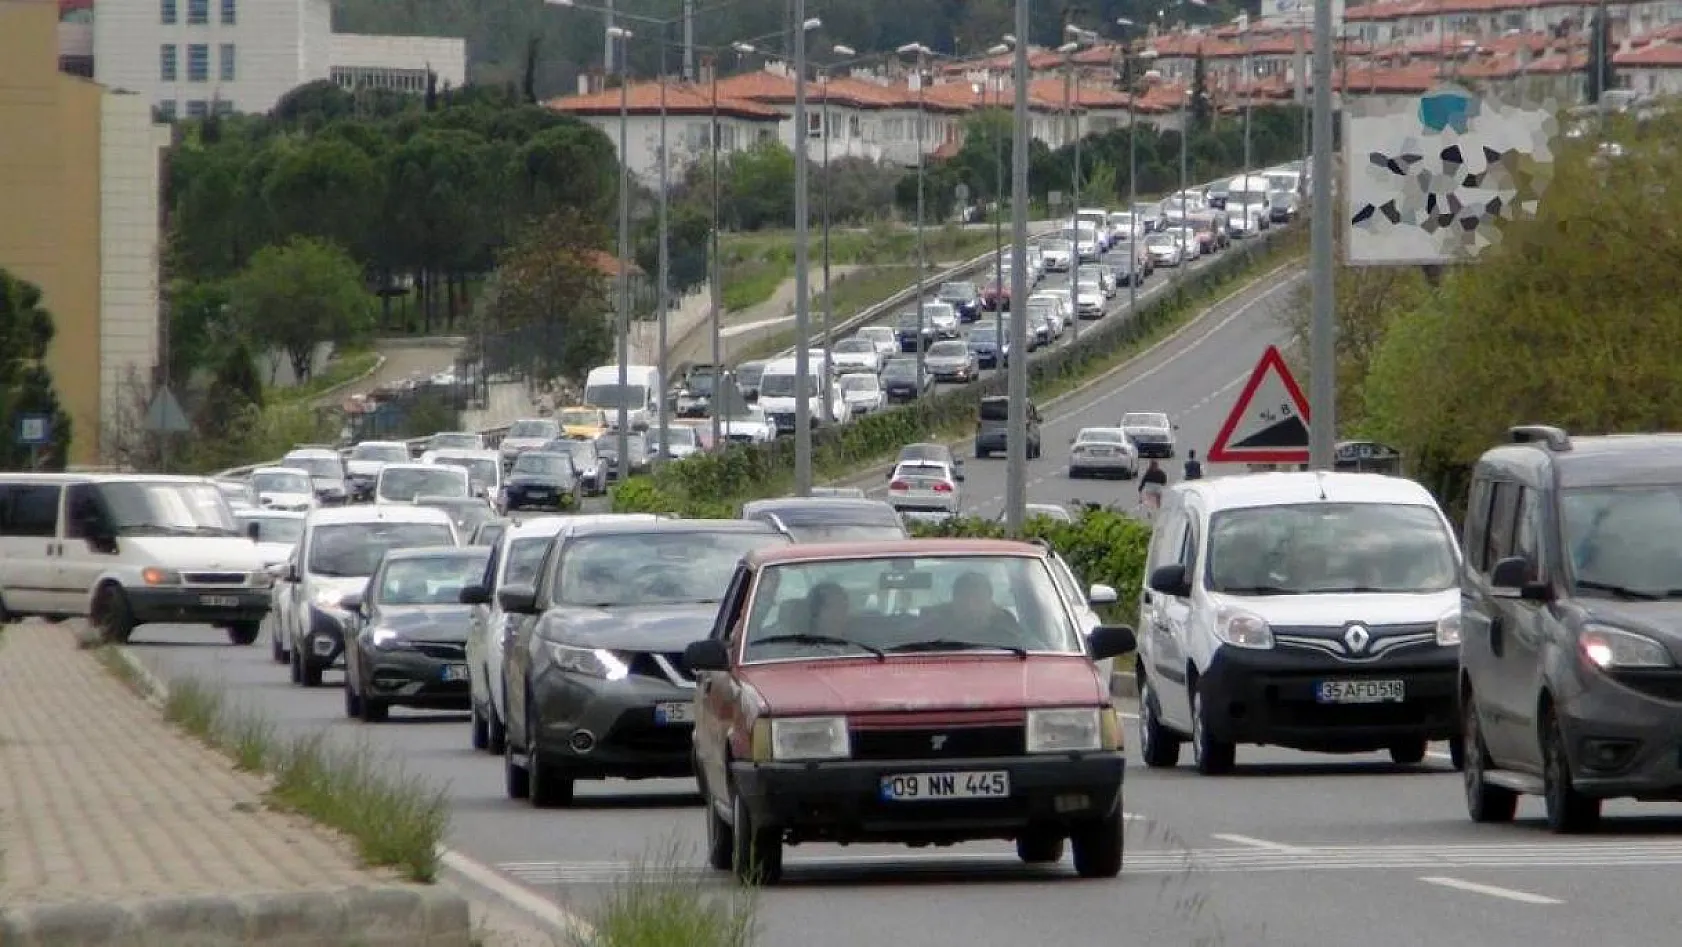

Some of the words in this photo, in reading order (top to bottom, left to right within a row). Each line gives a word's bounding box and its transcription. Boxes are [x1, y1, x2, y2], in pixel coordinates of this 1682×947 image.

[894, 777, 918, 796] 09
[928, 775, 955, 796] NN
[966, 773, 1005, 795] 445
